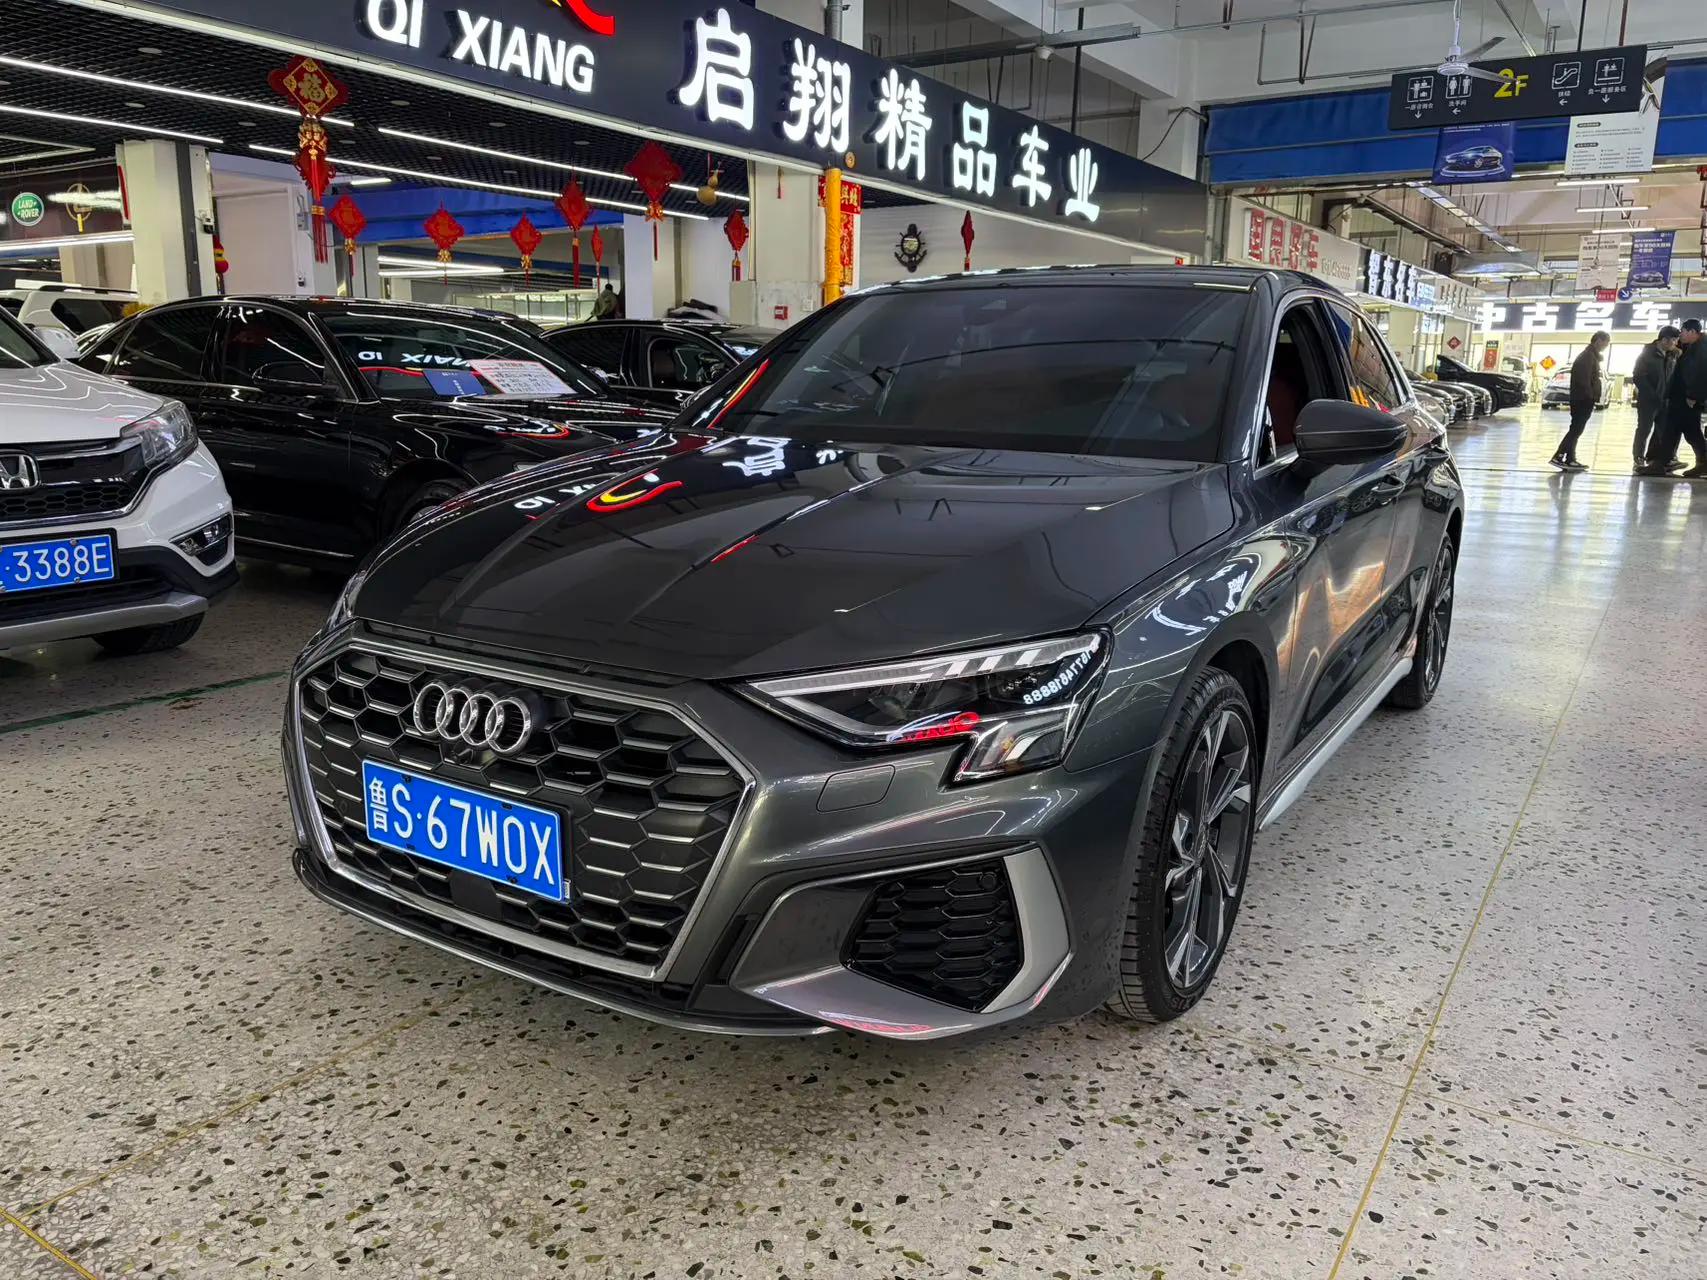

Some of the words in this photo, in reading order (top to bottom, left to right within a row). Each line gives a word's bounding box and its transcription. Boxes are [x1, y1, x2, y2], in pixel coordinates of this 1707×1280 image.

[367, 0, 424, 48] QI
[452, 9, 595, 93] XIANG
[1494, 68, 1529, 98] 2F
[679, 8, 1100, 222] 启翔精品车业
[18, 199, 33, 209] LAND
[20, 208, 39, 219] ROVER
[0, 542, 110, 585] ·3388E
